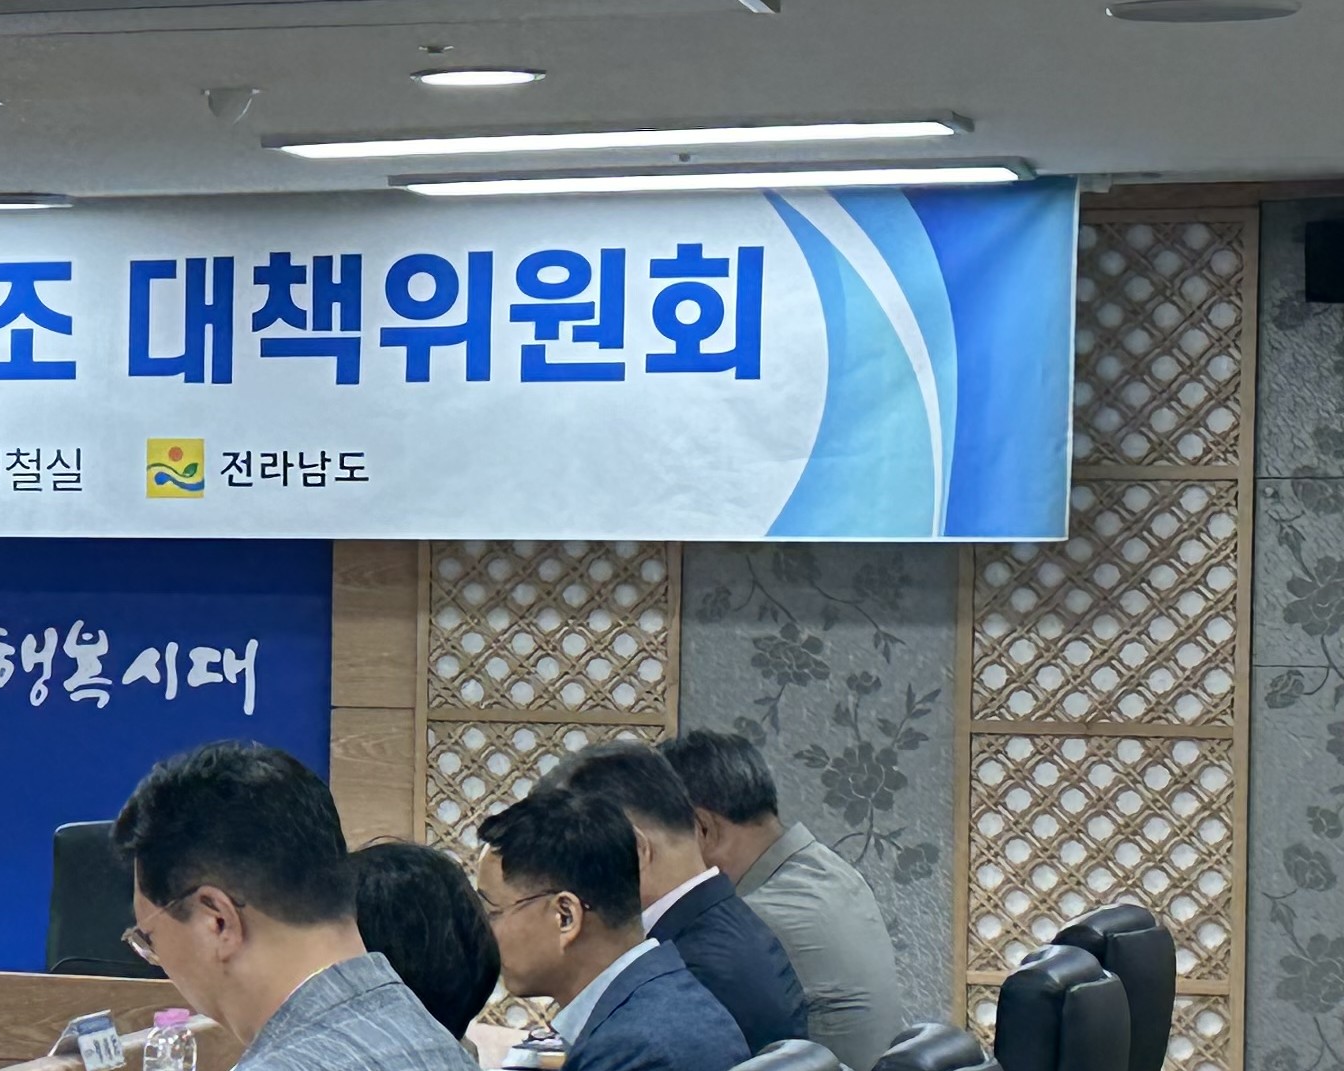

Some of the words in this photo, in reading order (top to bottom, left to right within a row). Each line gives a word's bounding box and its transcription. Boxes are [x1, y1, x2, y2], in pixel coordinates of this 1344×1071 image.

[127, 243, 765, 385] 대책위원회
[220, 450, 370, 488] 전라남도
[122, 639, 259, 716] 시대
